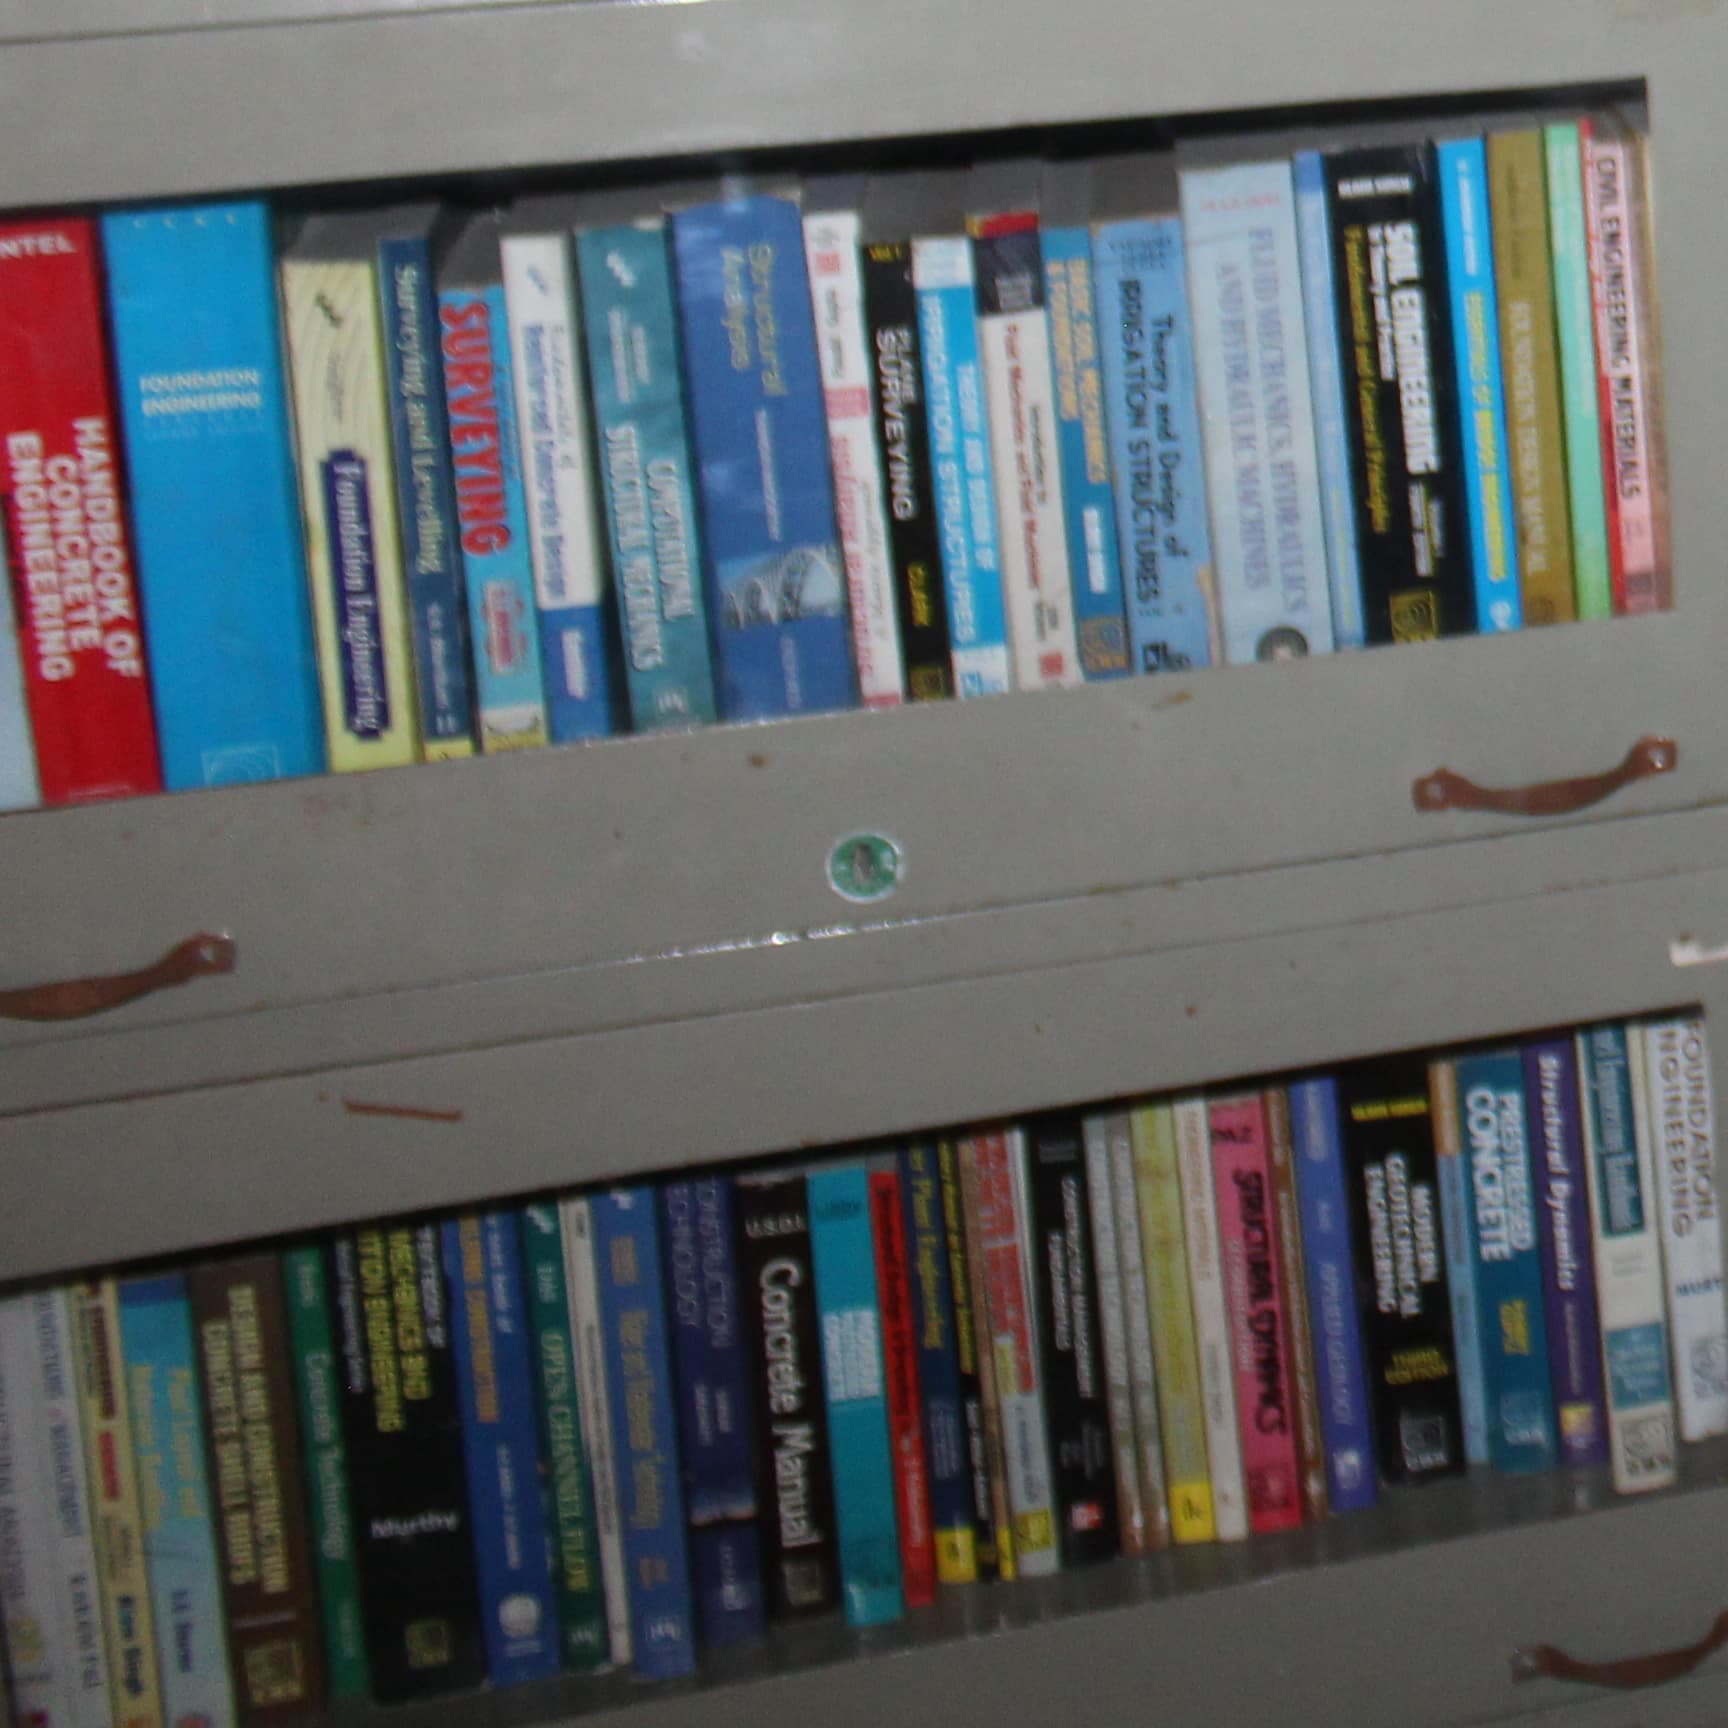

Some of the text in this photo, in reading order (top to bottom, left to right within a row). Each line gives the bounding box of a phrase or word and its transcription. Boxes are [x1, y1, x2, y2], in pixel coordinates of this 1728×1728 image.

[394, 263, 434, 398] Surveying
[720, 246, 751, 372] Analysis
[749, 242, 787, 397] Structural
[897, 327, 919, 404] PLANE
[1387, 221, 1444, 473] SOIL ENGINEERING
[1594, 155, 1646, 500] CIVIL ENGINEERING MATERIALS
[407, 404, 437, 450] and
[411, 458, 446, 575] Levelling
[441, 299, 513, 556] SURVEYING
[603, 423, 649, 553] STRUCTURAL
[874, 327, 918, 522] SURVEYING
[922, 294, 977, 643] IRRIGATION STRUCTURES
[1117, 278, 1165, 601] IRRIGATION STRUCTURES
[1148, 313, 1190, 558] Theory and Design of
[1216, 262, 1275, 590] AND HYDRAULIC MACHINES
[1249, 228, 1281, 302] FLUID
[1266, 461, 1310, 612] HYDRAULICS
[8, 429, 74, 682] ENGINEERING
[47, 455, 103, 651] CONCRETE
[72, 418, 141, 678] HANDBOOK OF
[332, 463, 388, 732] Foundation Engineering
[647, 459, 698, 620] COMPUTATIONAL
[1466, 1086, 1510, 1262] CONCRETE
[1499, 1090, 1536, 1251] PRESTRESSED
[1537, 1054, 1580, 1291] Structural Dynamics
[1658, 1030, 1694, 1238] NGINEERING
[1682, 1025, 1719, 1220] FOUNDATION
[1232, 1169, 1289, 1436] STRUCTURAL DYNAMICS
[1364, 1166, 1398, 1313] ENGINEERING
[1384, 1154, 1421, 1316] GEOTECHNICAL
[1408, 1184, 1438, 1283] MODERN
[241, 1374, 274, 1419] AND
[304, 1350, 346, 1560] Concrete Technology
[370, 1299, 407, 1434] ENGINEERING
[544, 1332, 594, 1595] OPEN CHANNEL FLOW
[758, 1256, 821, 1548] Concrete Manual
[251, 1423, 293, 1593] CONSTRUCTION
